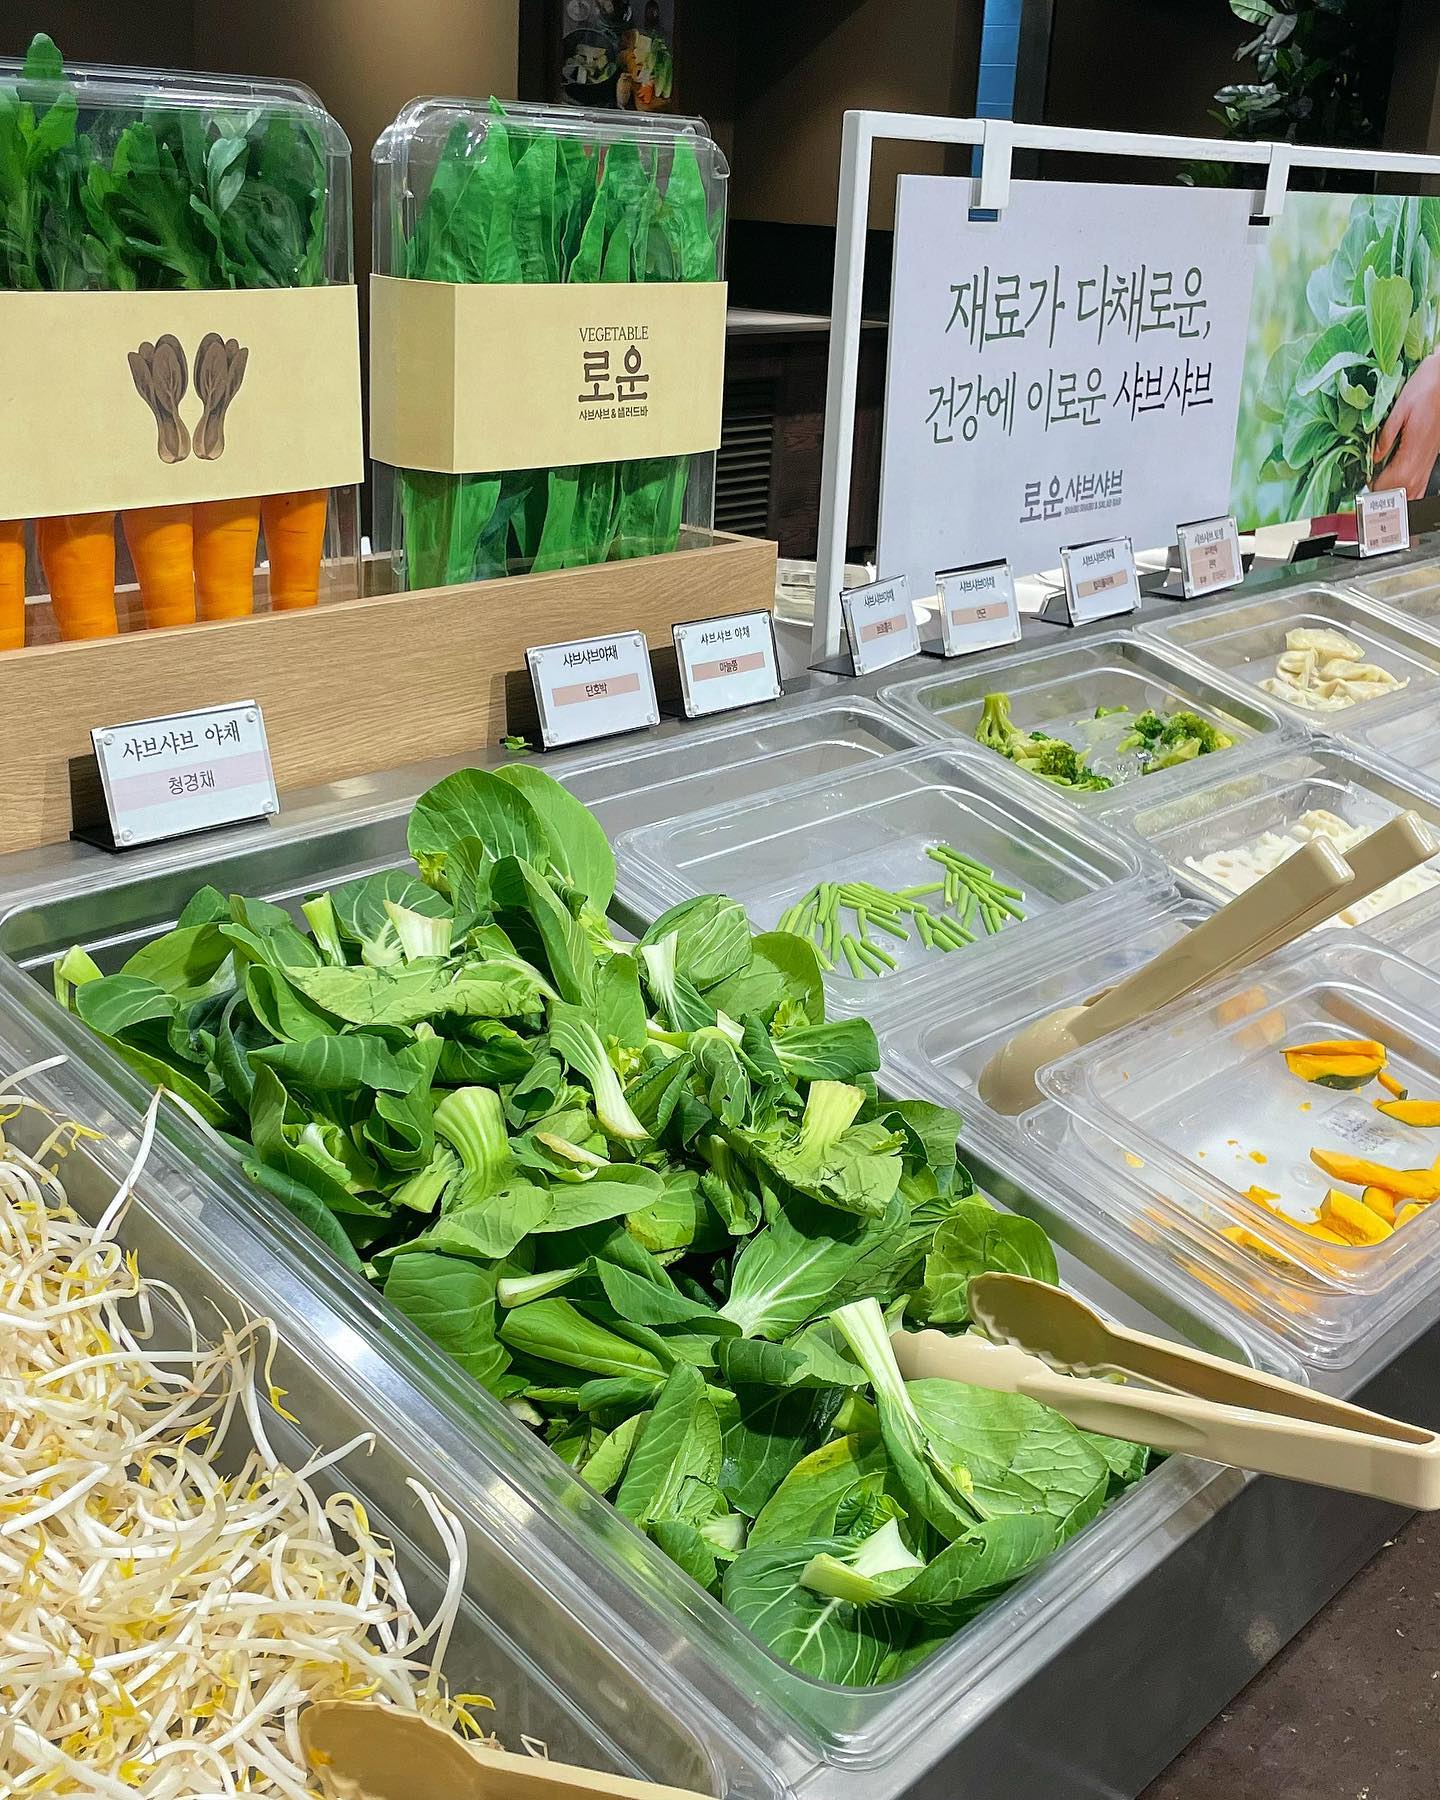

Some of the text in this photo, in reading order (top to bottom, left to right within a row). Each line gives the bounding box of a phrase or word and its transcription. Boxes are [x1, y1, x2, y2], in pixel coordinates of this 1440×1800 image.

[945, 264, 1211, 353] 재료가 다채로운,
[579, 326, 649, 342] VEGETABLE
[578, 345, 649, 402] 로운
[925, 358, 1213, 443] 건강에 이로운 샤브샤브
[701, 625, 750, 646] 샤브샤브 야채
[585, 682, 608, 698] 단호박
[122, 720, 241, 762] 샤브샤브 야채
[168, 770, 216, 796] 청경채
